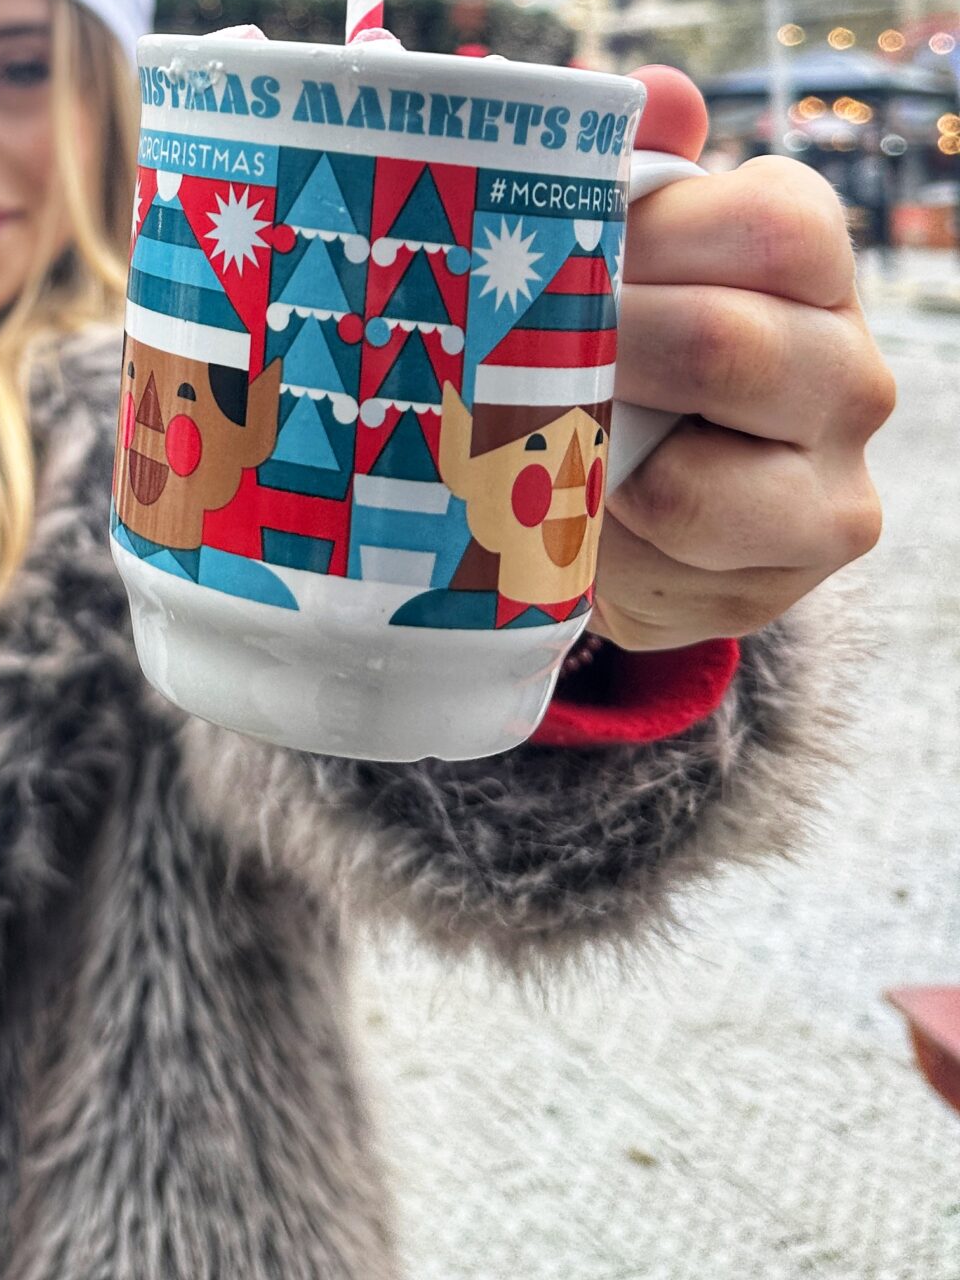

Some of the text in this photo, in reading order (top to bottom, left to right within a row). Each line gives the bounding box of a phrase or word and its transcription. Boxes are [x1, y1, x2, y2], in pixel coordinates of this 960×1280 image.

[292, 81, 570, 151] MARKETS
[575, 109, 631, 157] 202
[489, 178, 628, 213] #MCRCHRISTM
